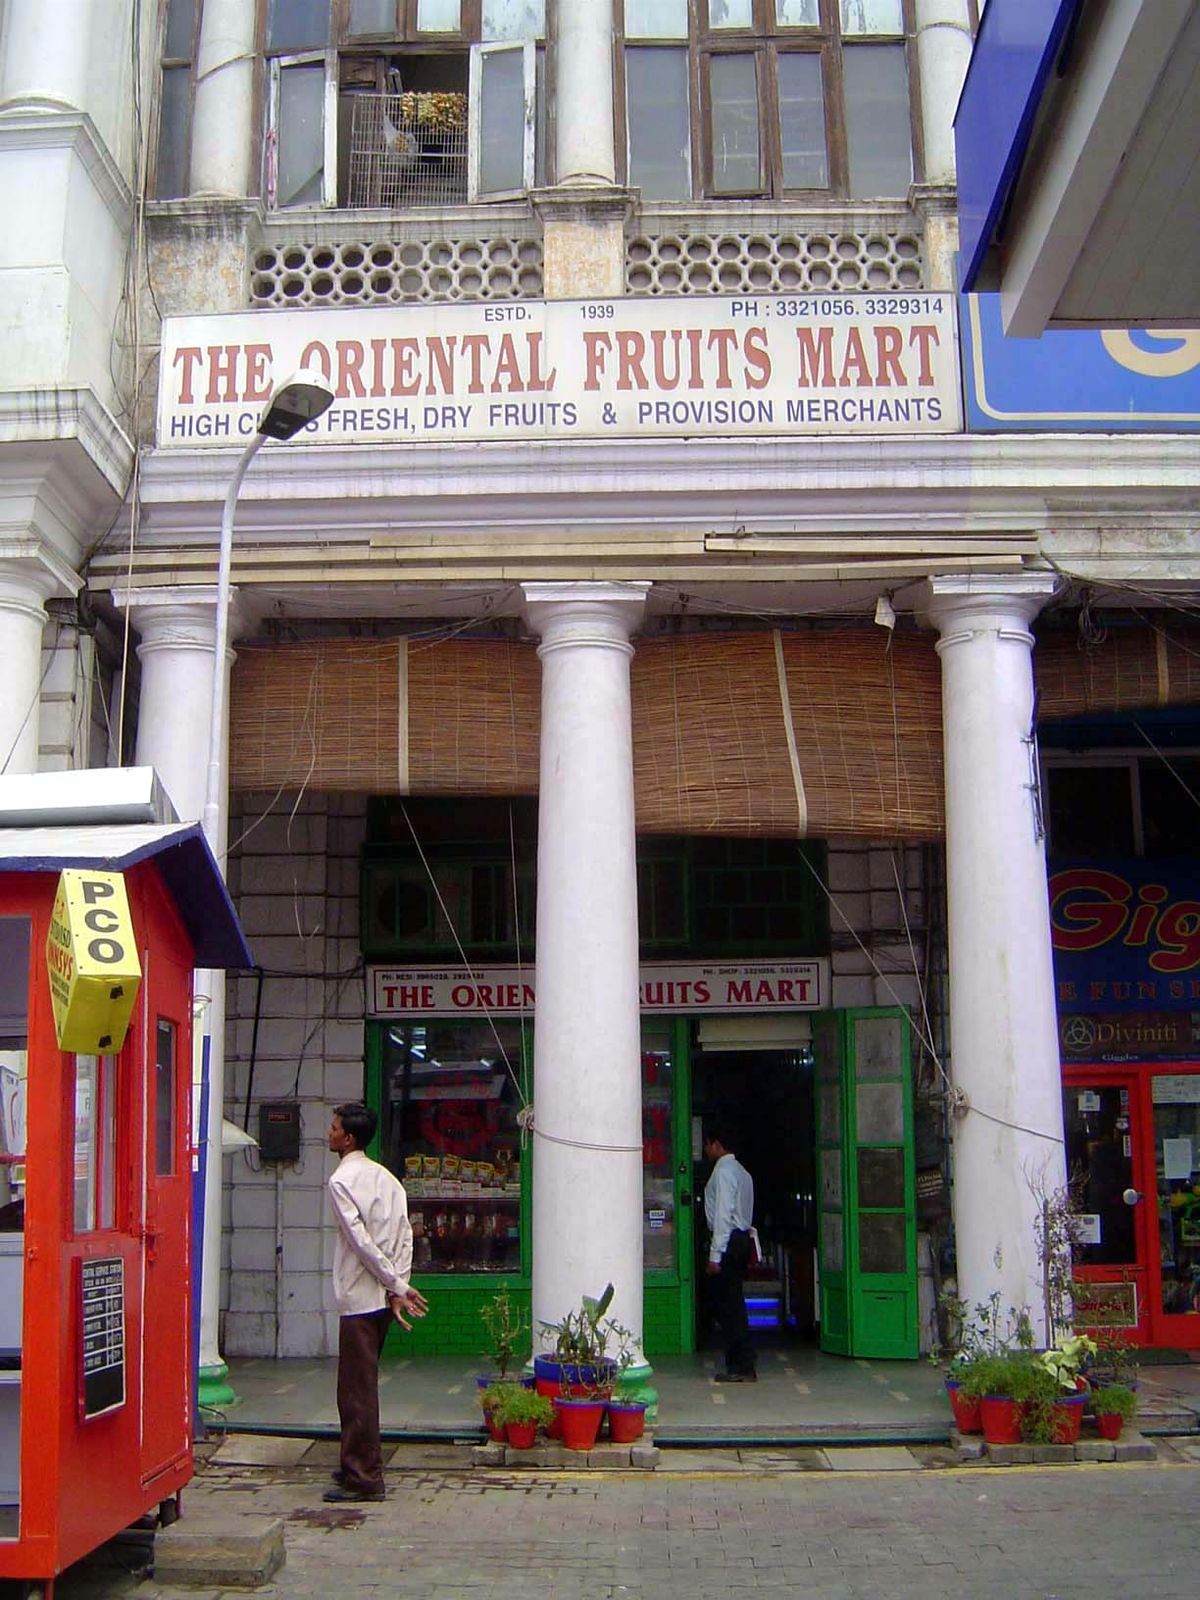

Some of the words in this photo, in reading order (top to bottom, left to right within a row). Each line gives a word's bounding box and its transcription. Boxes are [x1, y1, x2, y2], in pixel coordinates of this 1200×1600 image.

[580, 304, 614, 319] 1939
[865, 298, 944, 315] 3329314
[173, 344, 274, 405] THE
[300, 331, 557, 398] ORIENTAL
[583, 326, 772, 391] FRUITS
[796, 325, 940, 388] MART
[170, 413, 230, 438] HIGH
[327, 407, 416, 434] FRESH,
[423, 405, 472, 429] DRY
[489, 402, 577, 428] FRUITS
[602, 402, 617, 425] &
[638, 399, 774, 425] PROVISION
[786, 397, 942, 423] MERCHANTS
[81, 880, 125, 964] PCO
[383, 985, 435, 1008] THE
[640, 980, 711, 1005] UITS
[727, 978, 811, 1004] MART
[1090, 980, 1157, 1000] FUN
